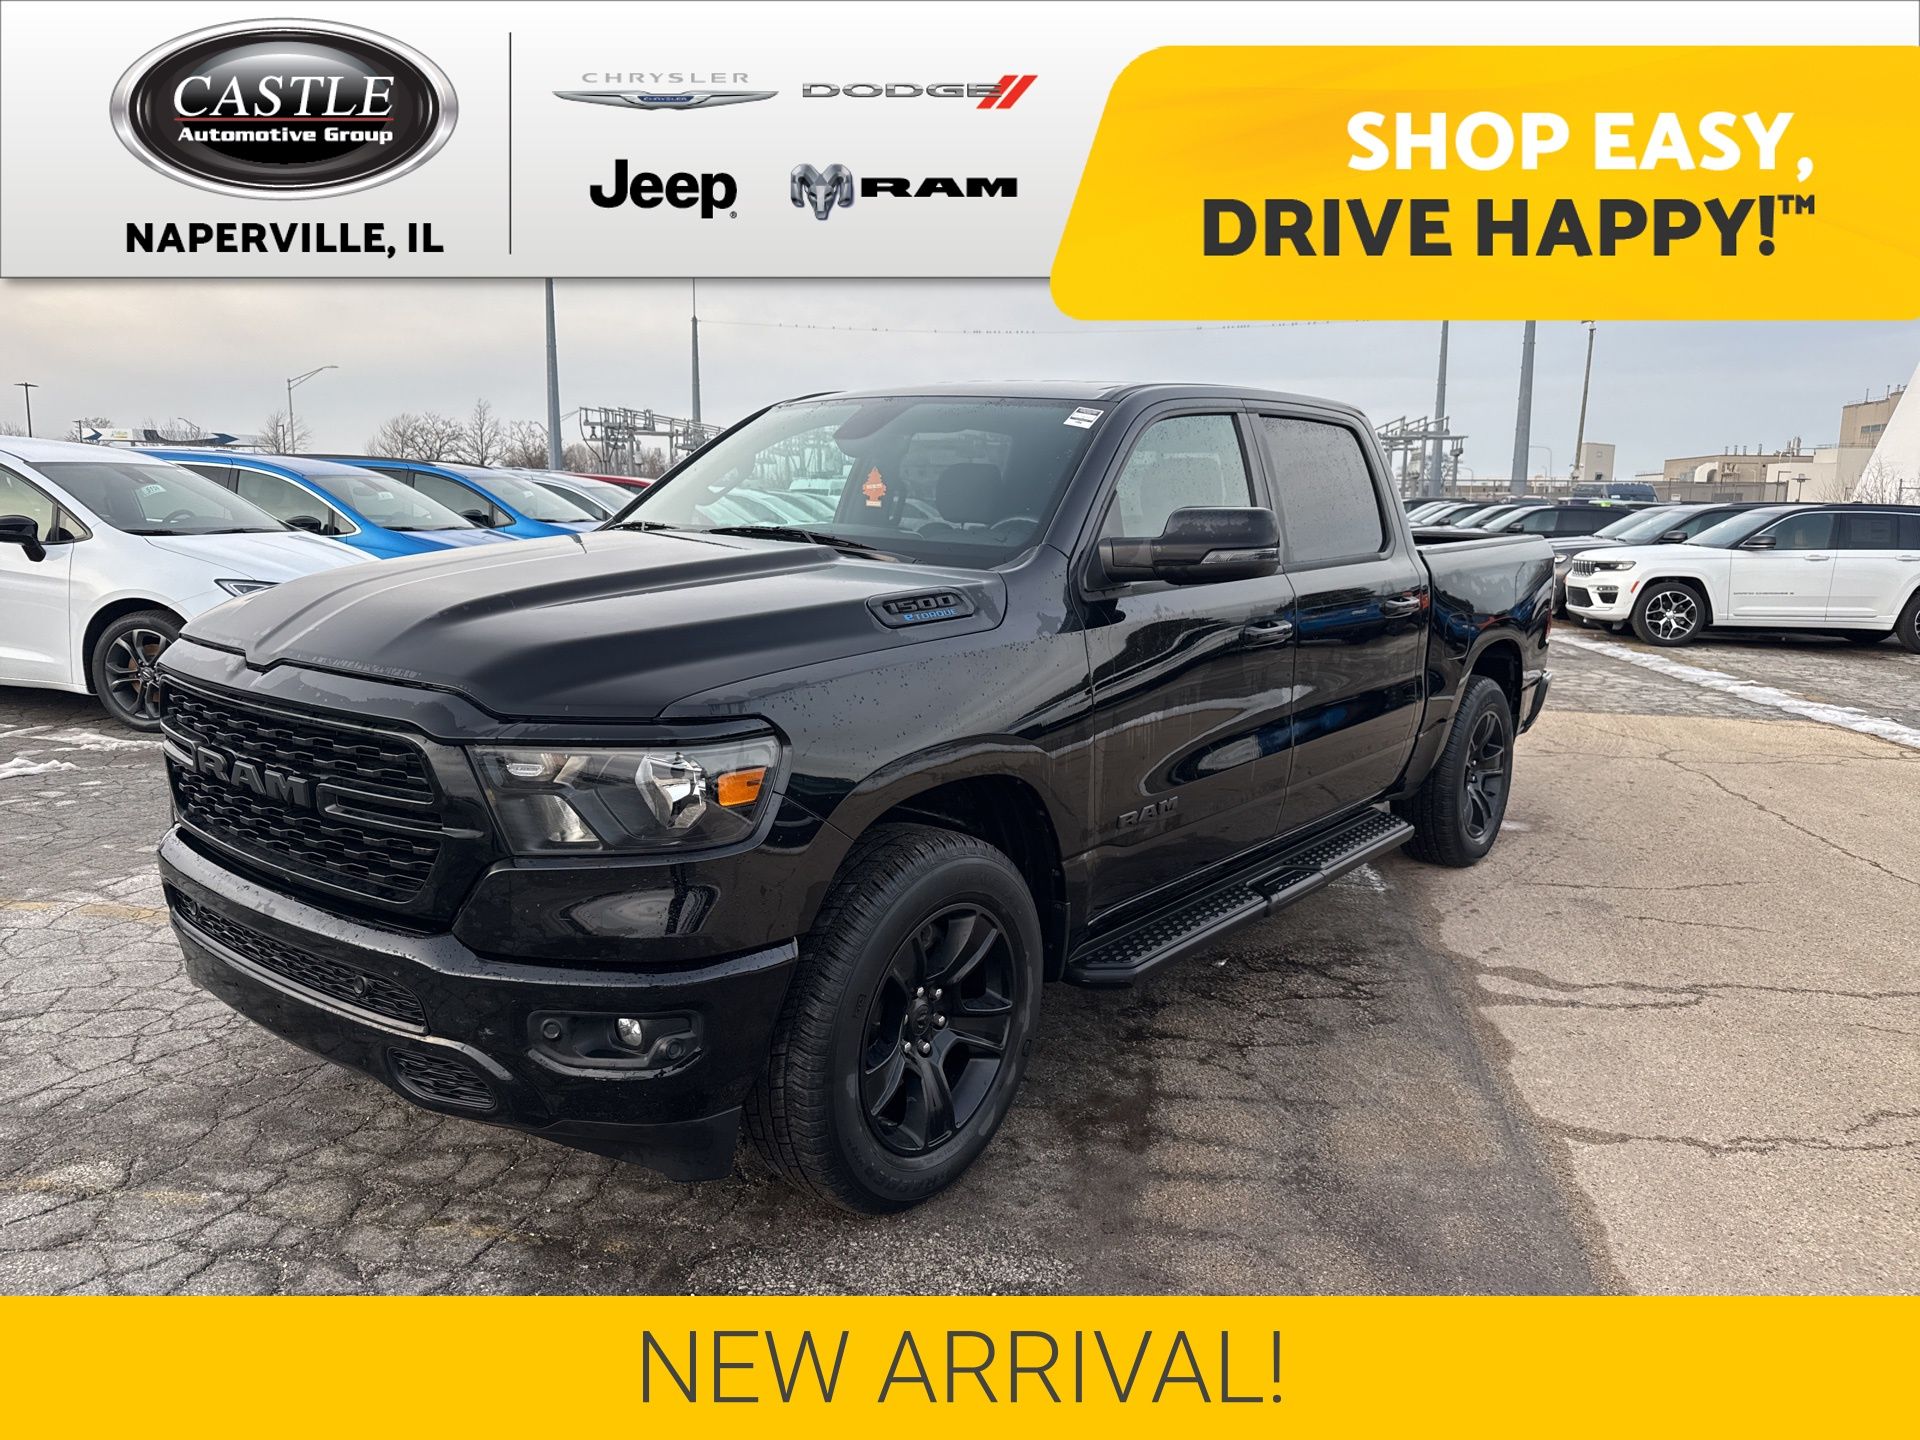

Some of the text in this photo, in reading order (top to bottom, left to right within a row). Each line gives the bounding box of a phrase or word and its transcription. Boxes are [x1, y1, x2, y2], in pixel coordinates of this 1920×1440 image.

[883, 595, 956, 614] 1500
[197, 746, 311, 808] RAM
[1117, 795, 1179, 829] RAM
